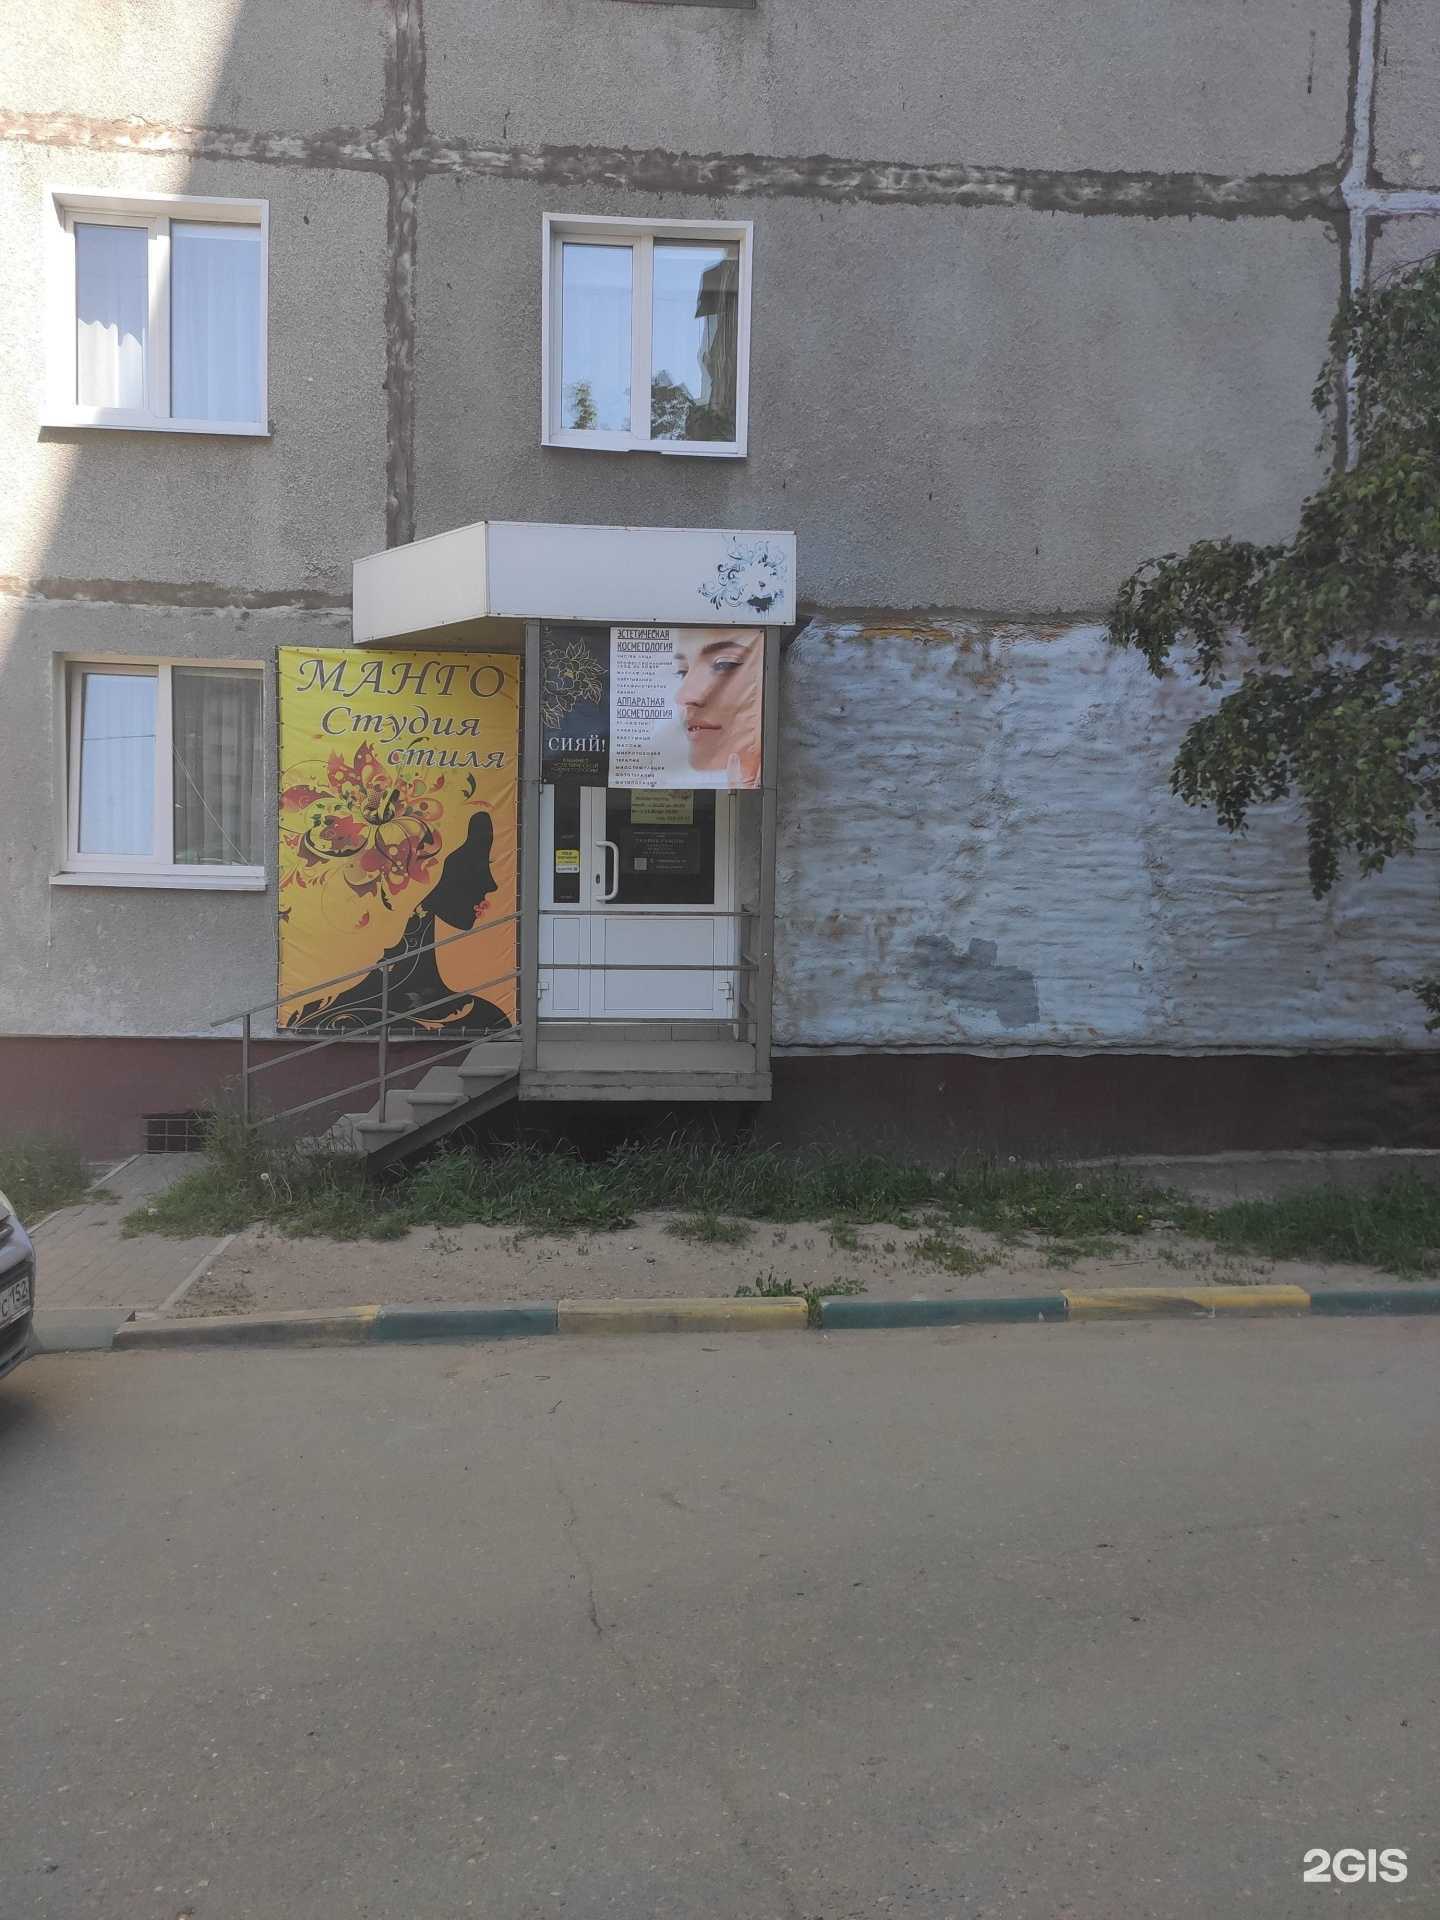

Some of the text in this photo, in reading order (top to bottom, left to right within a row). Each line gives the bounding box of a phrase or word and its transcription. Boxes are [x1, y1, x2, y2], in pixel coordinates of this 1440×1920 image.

[616, 629, 670, 640] ЭСТЕТИЧЕСКАЯ
[617, 641, 673, 652] КОСМЕТОЛОГИЯ
[616, 696, 665, 707] АППАРАТНАЯ
[616, 709, 672, 719] КОСМЕТОЛОГИЯ
[322, 704, 480, 743] Студия
[548, 734, 605, 753] СИЯЙ!
[387, 736, 505, 769] стиля
